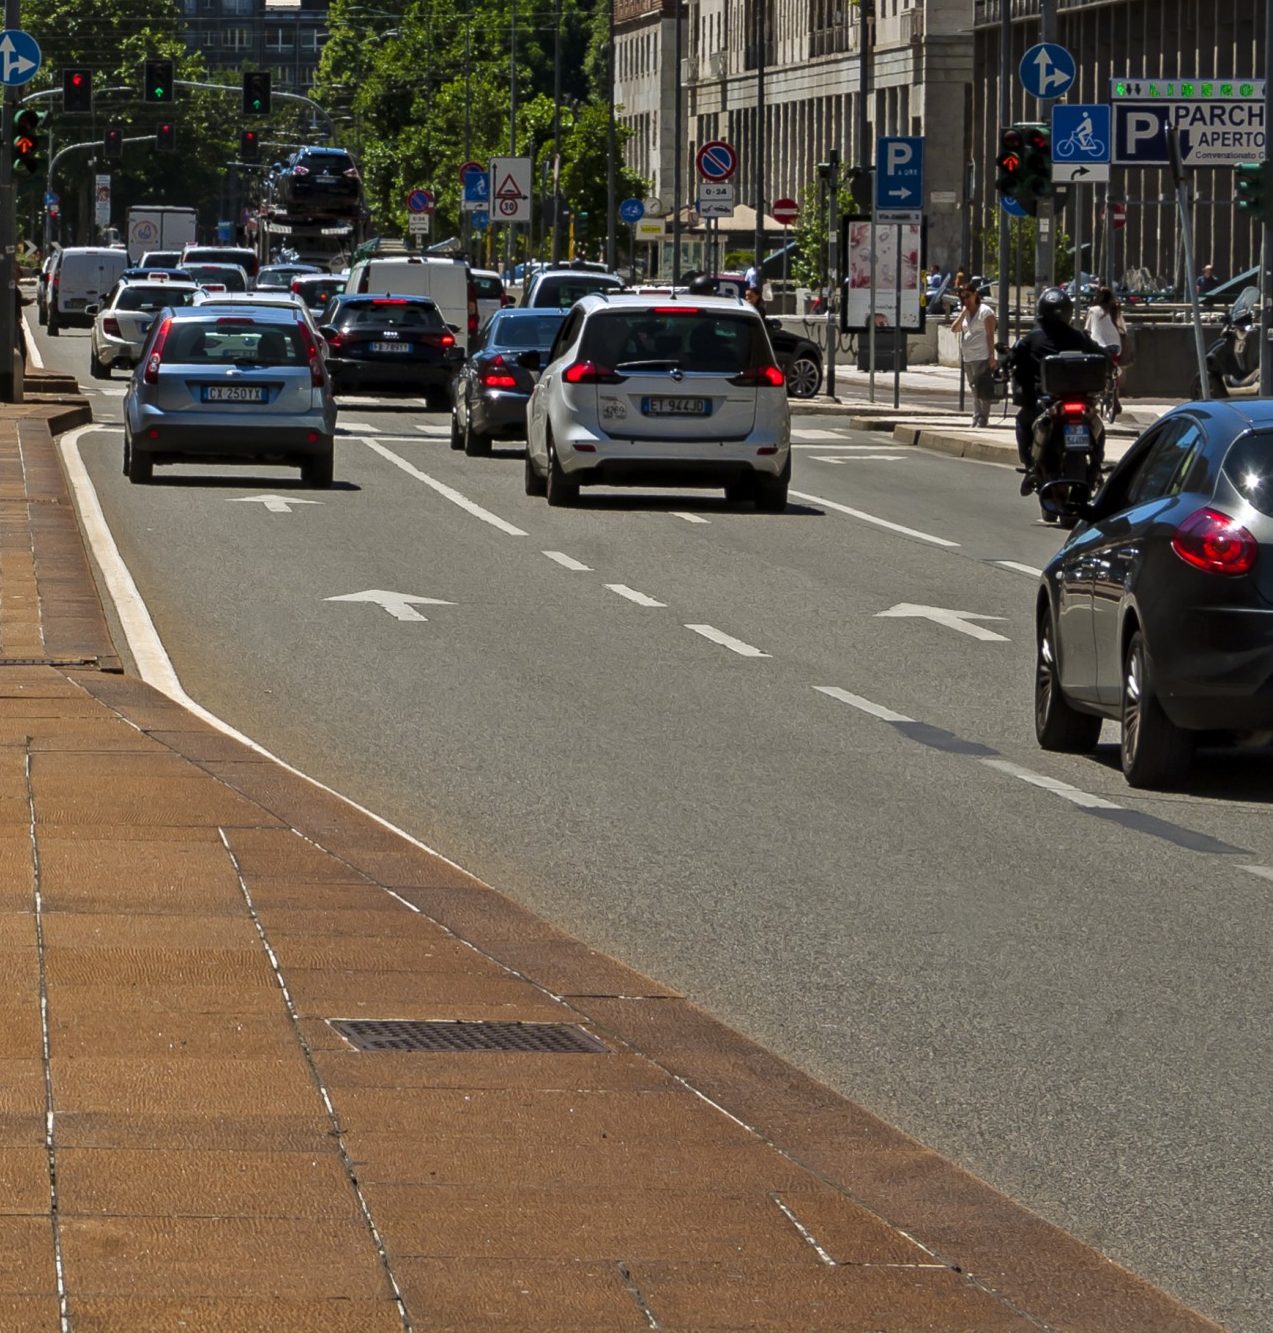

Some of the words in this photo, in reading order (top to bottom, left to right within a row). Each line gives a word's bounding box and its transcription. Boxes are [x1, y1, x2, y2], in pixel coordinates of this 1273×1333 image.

[1149, 83, 1253, 97] LIBERO
[1127, 112, 1159, 154] P
[1198, 132, 1265, 147] APERTO
[887, 142, 913, 176] P
[1195, 151, 1256, 160] Convenzionato
[503, 202, 514, 211] 30
